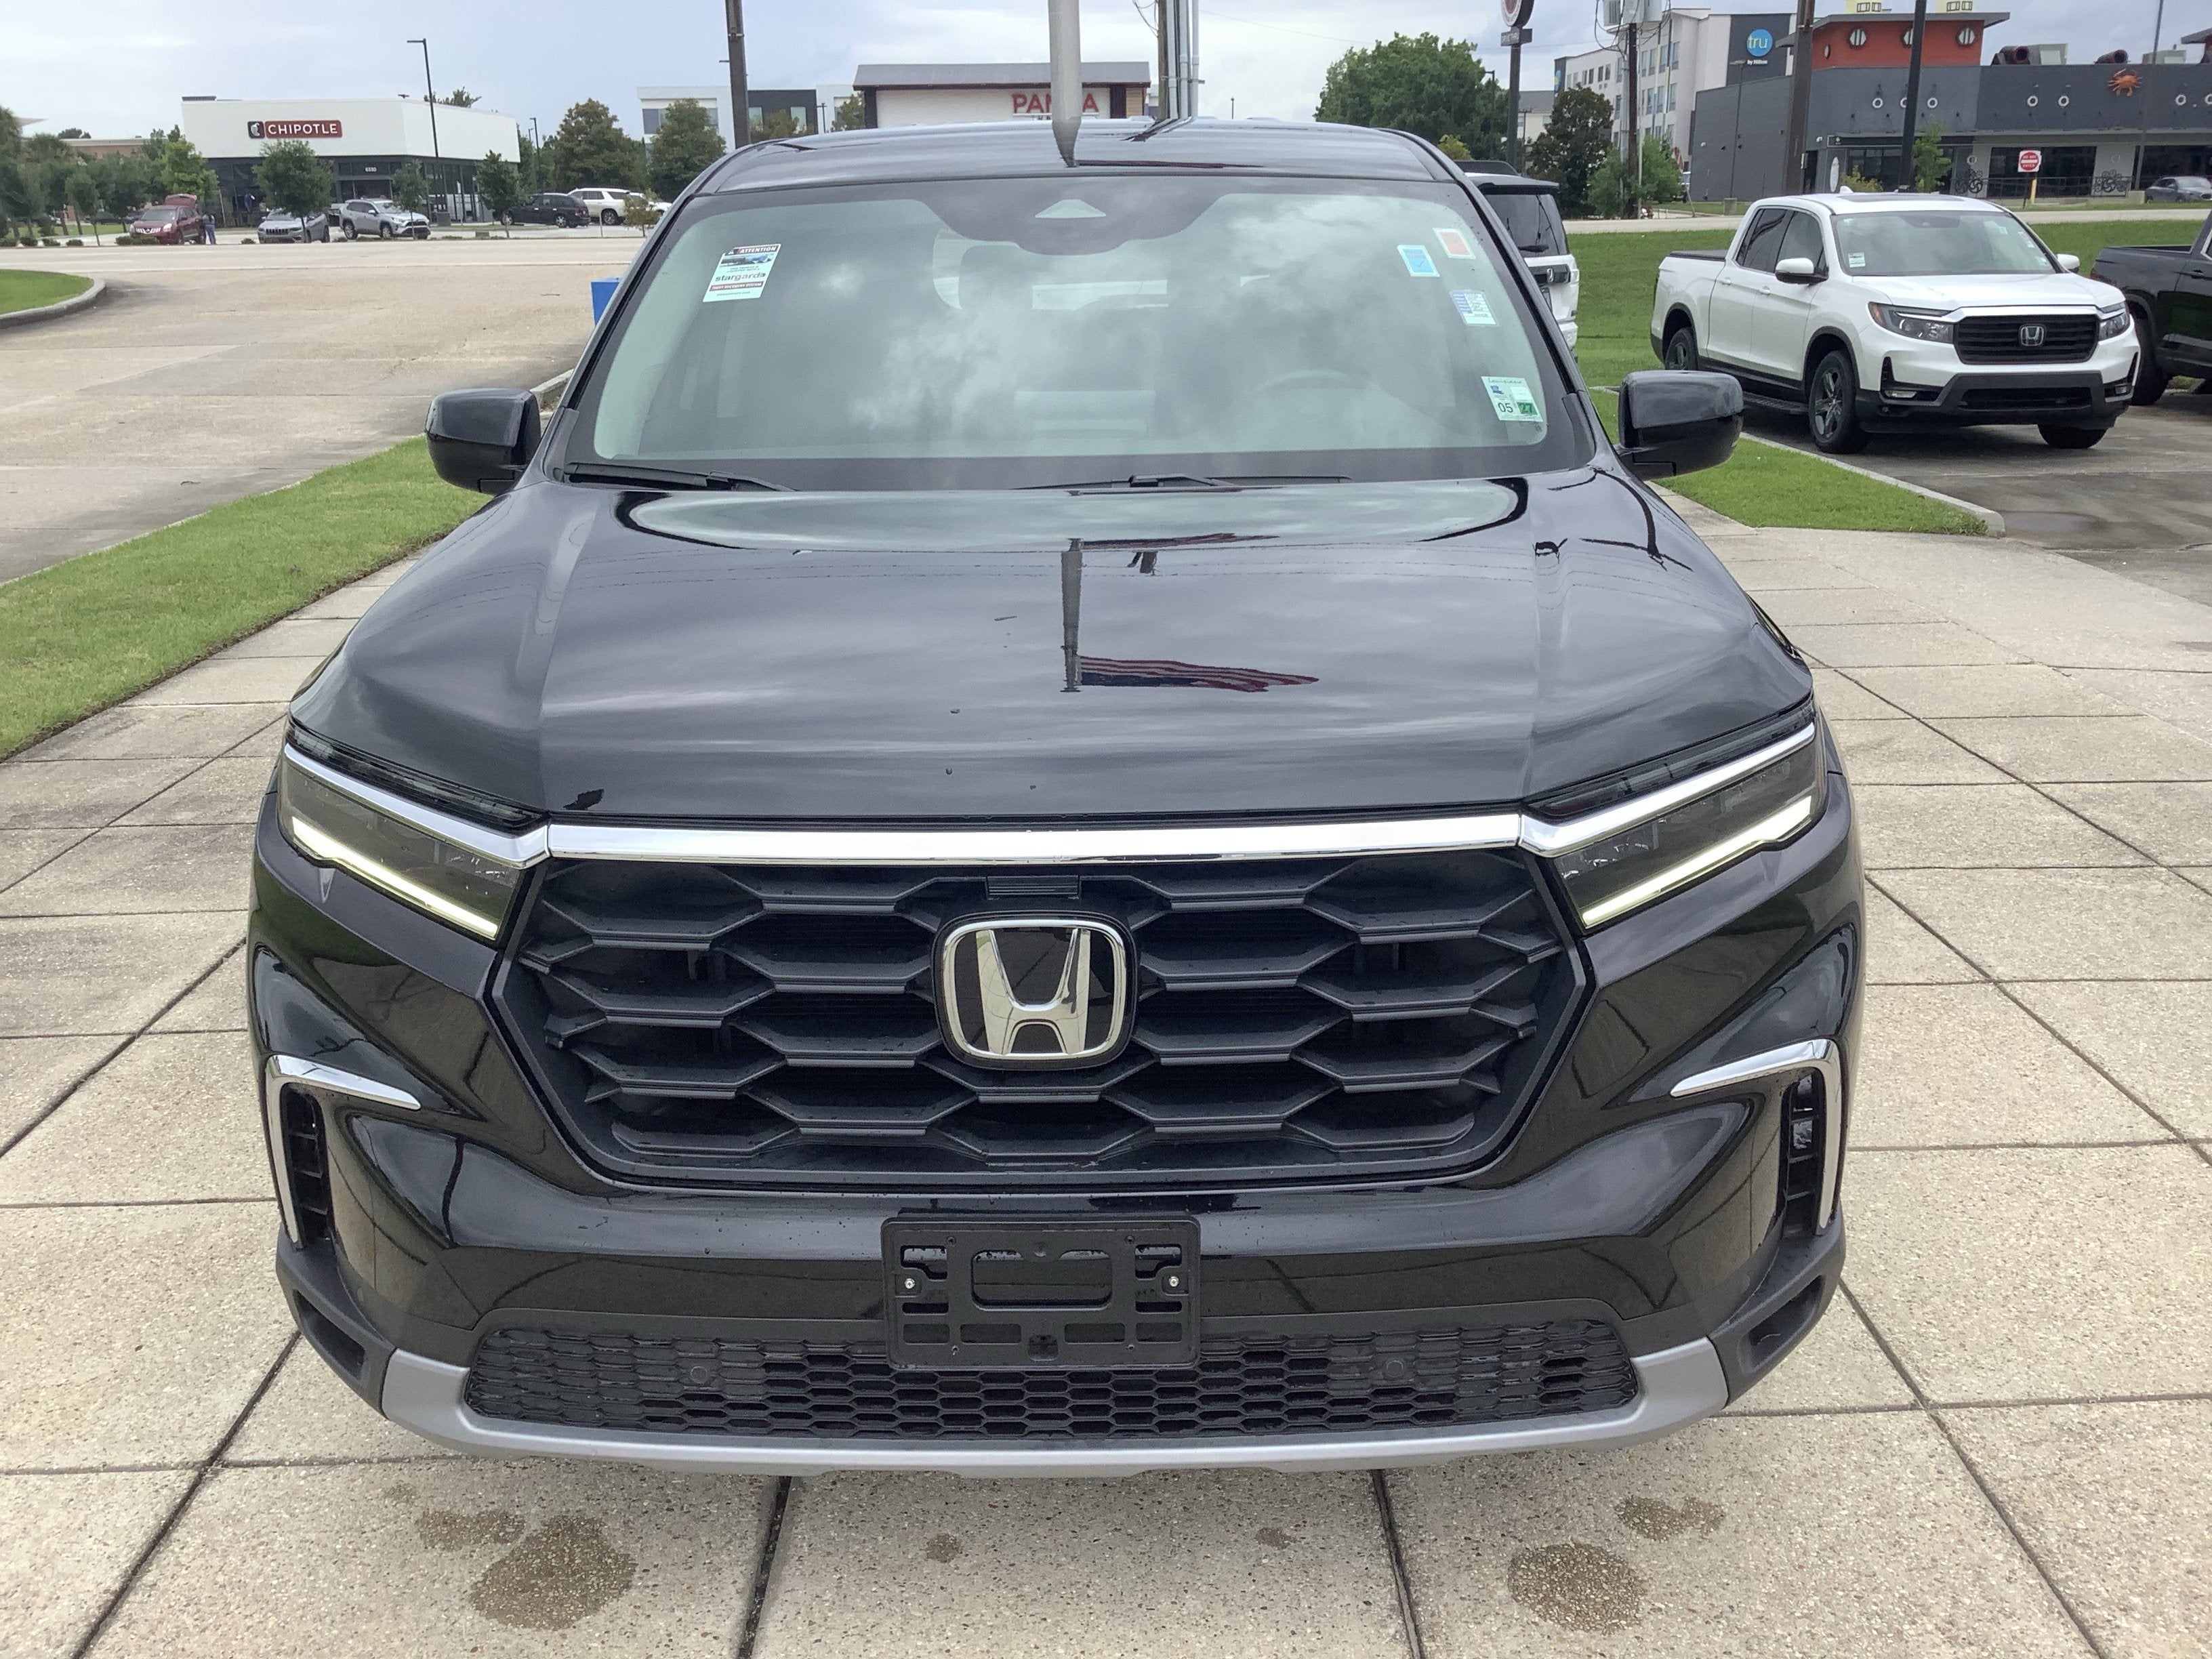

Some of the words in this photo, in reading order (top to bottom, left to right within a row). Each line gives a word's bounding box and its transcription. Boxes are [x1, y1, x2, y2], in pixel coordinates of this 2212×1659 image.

[1748, 35, 1768, 49] tru
[1012, 94, 1099, 113] PAA
[268, 123, 338, 135] CHIPOTLE
[1498, 403, 1513, 413] 05
[1519, 403, 1534, 414] 27
